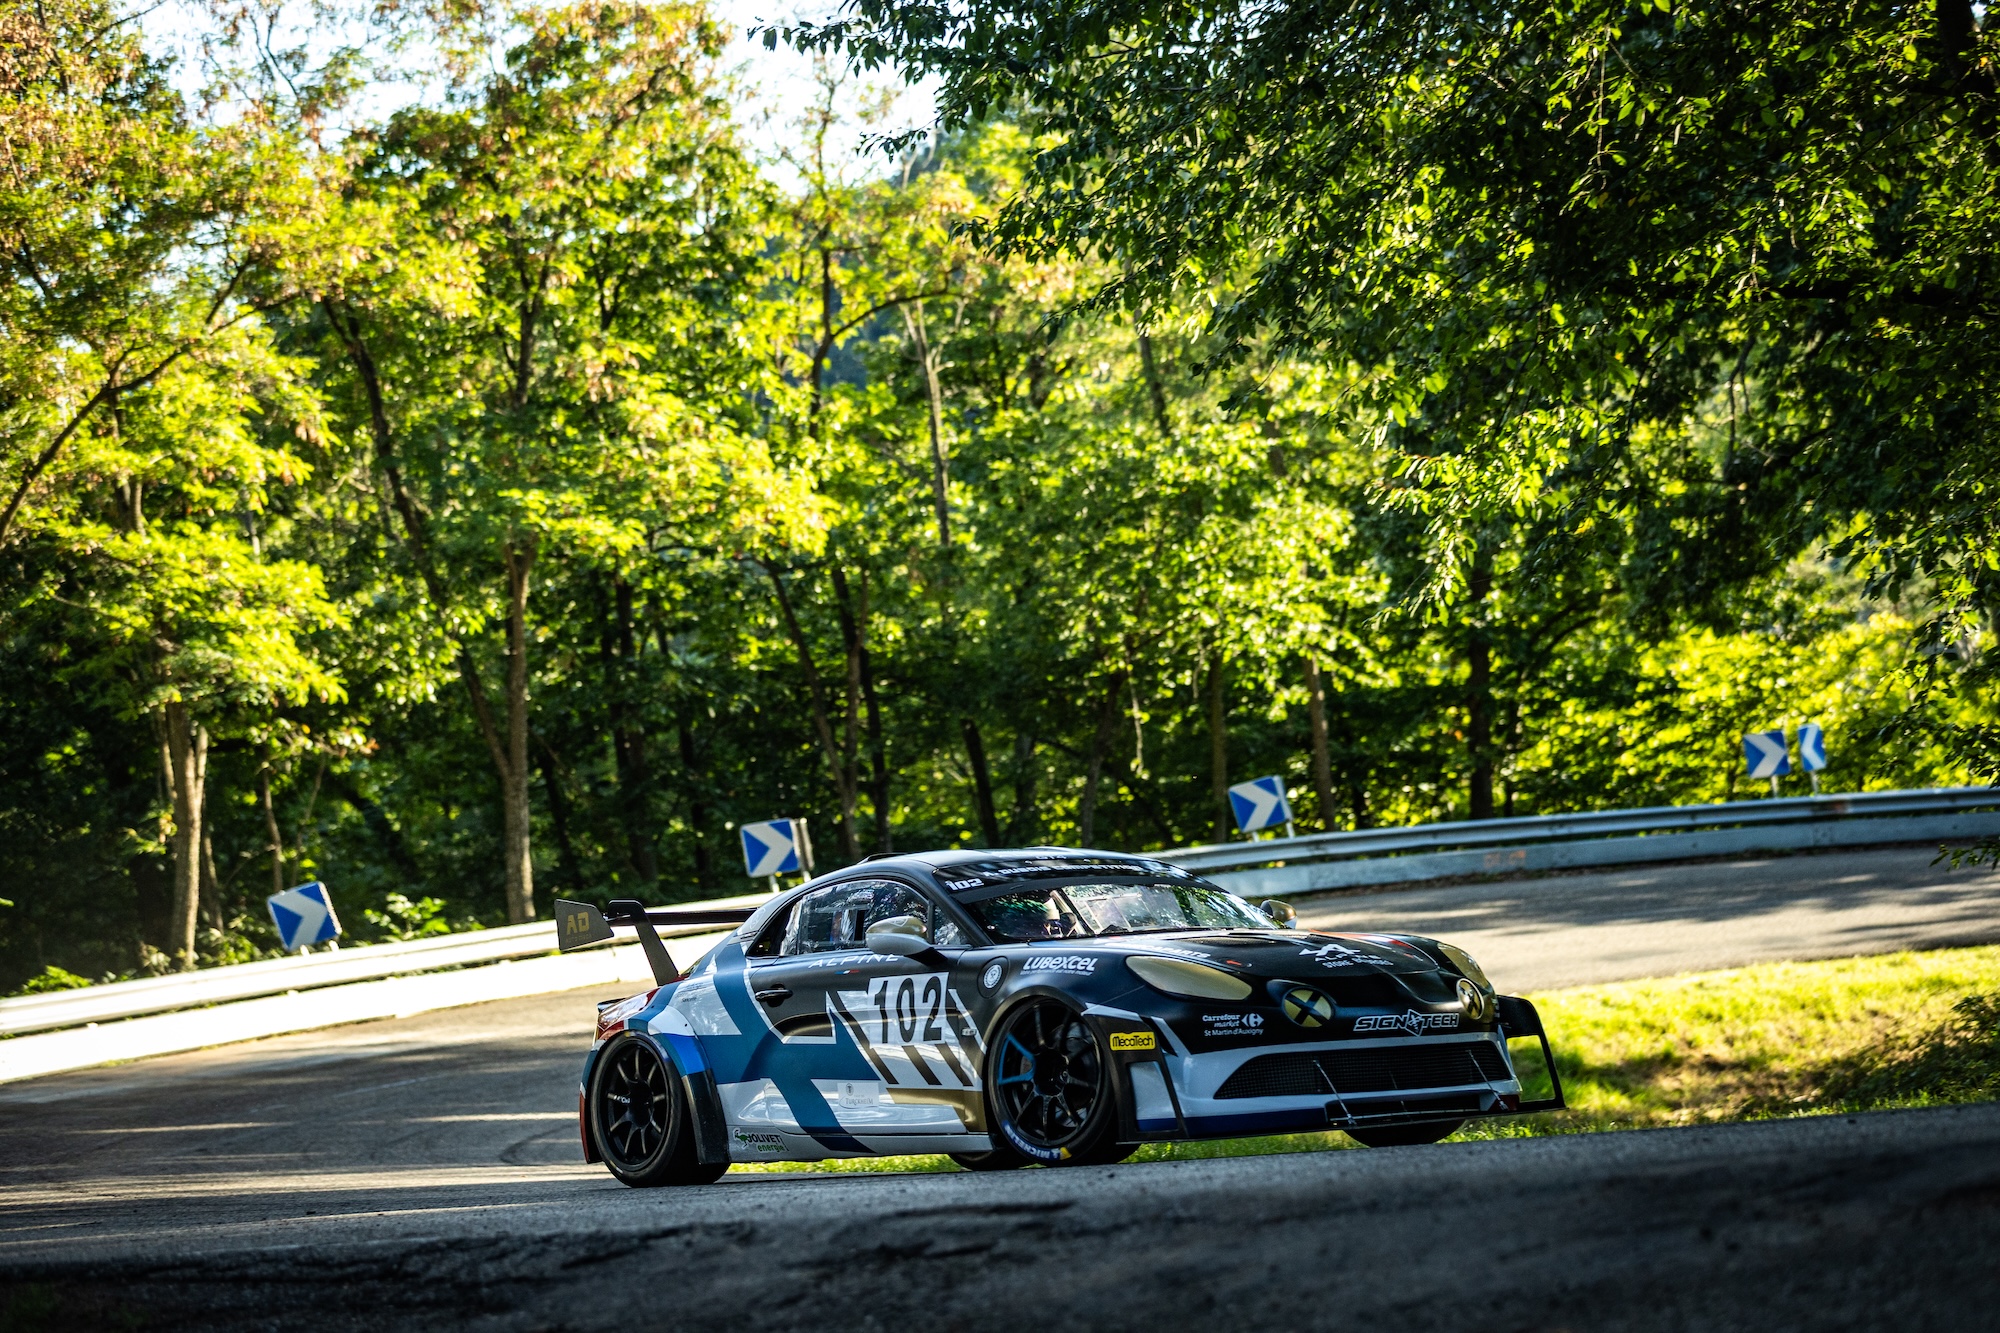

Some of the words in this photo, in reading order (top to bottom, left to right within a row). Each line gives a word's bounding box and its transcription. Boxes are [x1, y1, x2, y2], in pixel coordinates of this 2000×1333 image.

[945, 878, 984, 891] 102
[566, 911, 590, 936] AD
[808, 953, 900, 968] ALPINE
[874, 976, 942, 1044] 102
[1202, 1014, 1241, 1022] Carrefour
[1213, 1020, 1240, 1028] market
[1212, 1028, 1233, 1036] Martin
[748, 1133, 782, 1143] JOLIVET
[1004, 1125, 1050, 1159] MICHELIN
